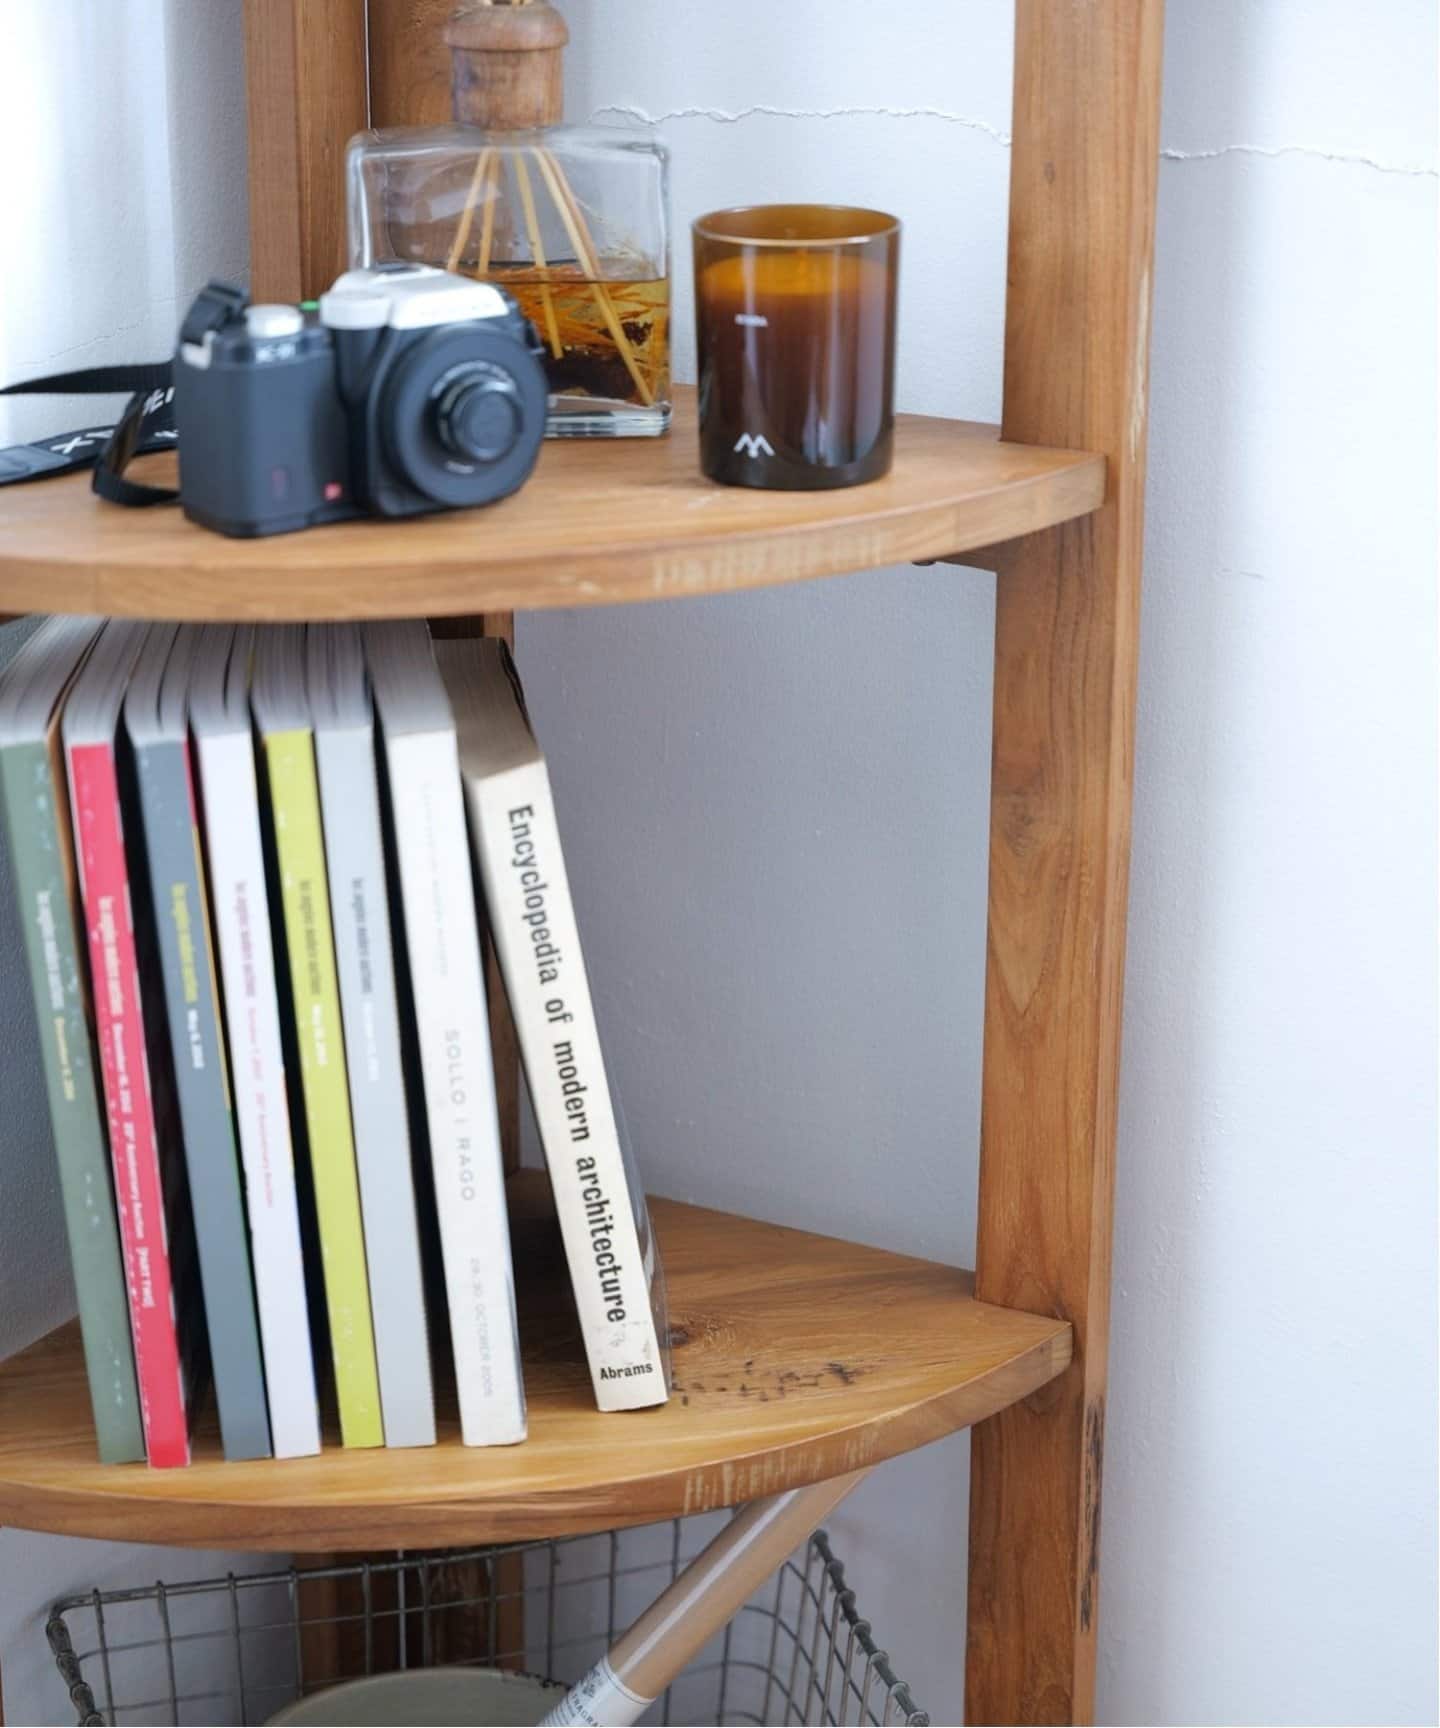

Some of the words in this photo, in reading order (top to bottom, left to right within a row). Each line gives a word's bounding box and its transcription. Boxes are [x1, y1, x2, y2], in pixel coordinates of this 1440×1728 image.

[508, 804, 559, 985] Encyclopedia
[545, 998, 573, 1025] of
[445, 1030, 466, 1106] SOLLO
[456, 1137, 476, 1202] RAGO
[553, 1040, 591, 1145] modern
[576, 1155, 627, 1323] architecture
[600, 1362, 653, 1381] Abrams
